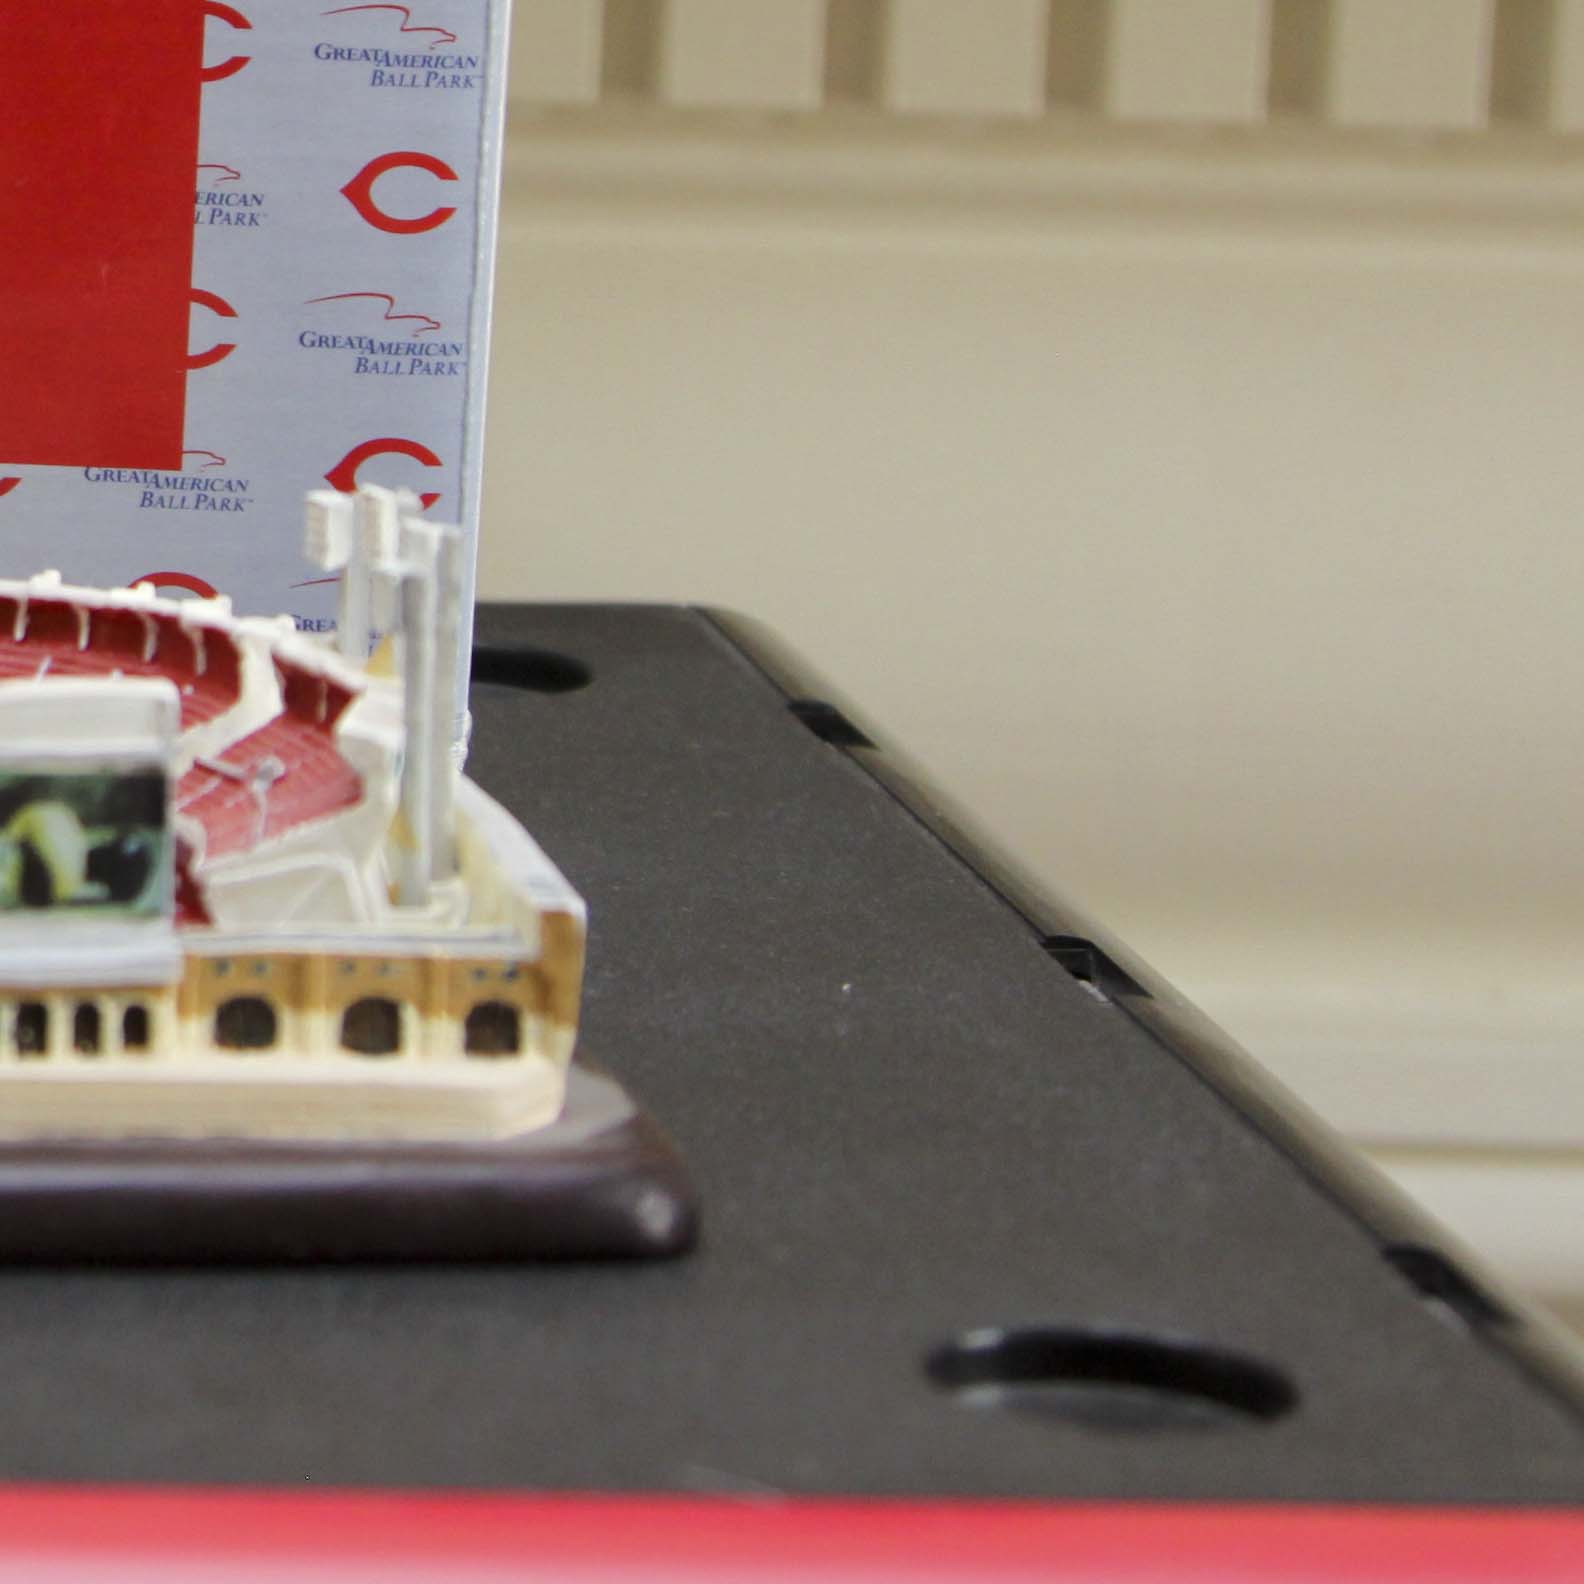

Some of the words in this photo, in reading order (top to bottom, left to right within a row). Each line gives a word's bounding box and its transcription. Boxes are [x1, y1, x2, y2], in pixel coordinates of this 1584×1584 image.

[370, 69, 420, 88] BALL
[424, 71, 473, 89] PARK
[208, 207, 261, 227] PARK
[354, 357, 404, 376] BALL
[408, 358, 458, 376] PARK
[139, 491, 189, 510] BALL
[193, 494, 244, 513] PARK
